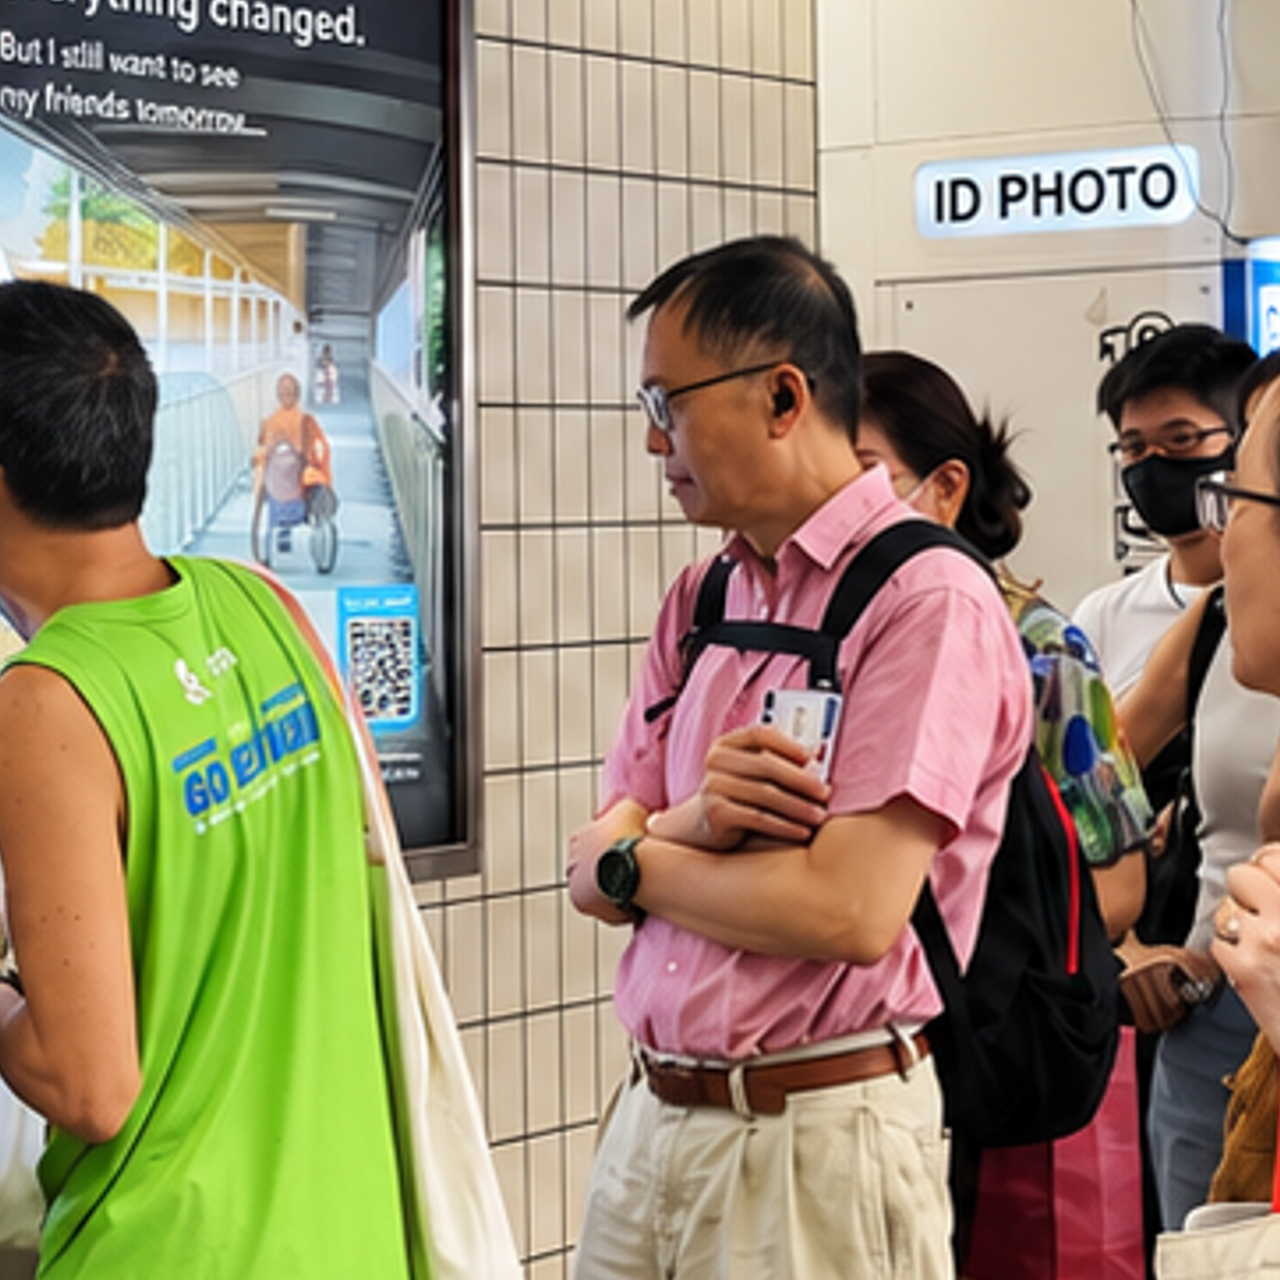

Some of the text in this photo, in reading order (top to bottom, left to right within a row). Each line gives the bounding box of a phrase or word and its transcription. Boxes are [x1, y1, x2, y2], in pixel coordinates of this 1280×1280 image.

[0, 30, 42, 64] But
[61, 40, 104, 71] still
[109, 50, 165, 81] want
[172, 58, 196, 83] to
[200, 64, 240, 89] see
[0, 88, 38, 120] my
[44, 82, 130, 119] friends
[934, 163, 1177, 223] ID PHOTO
